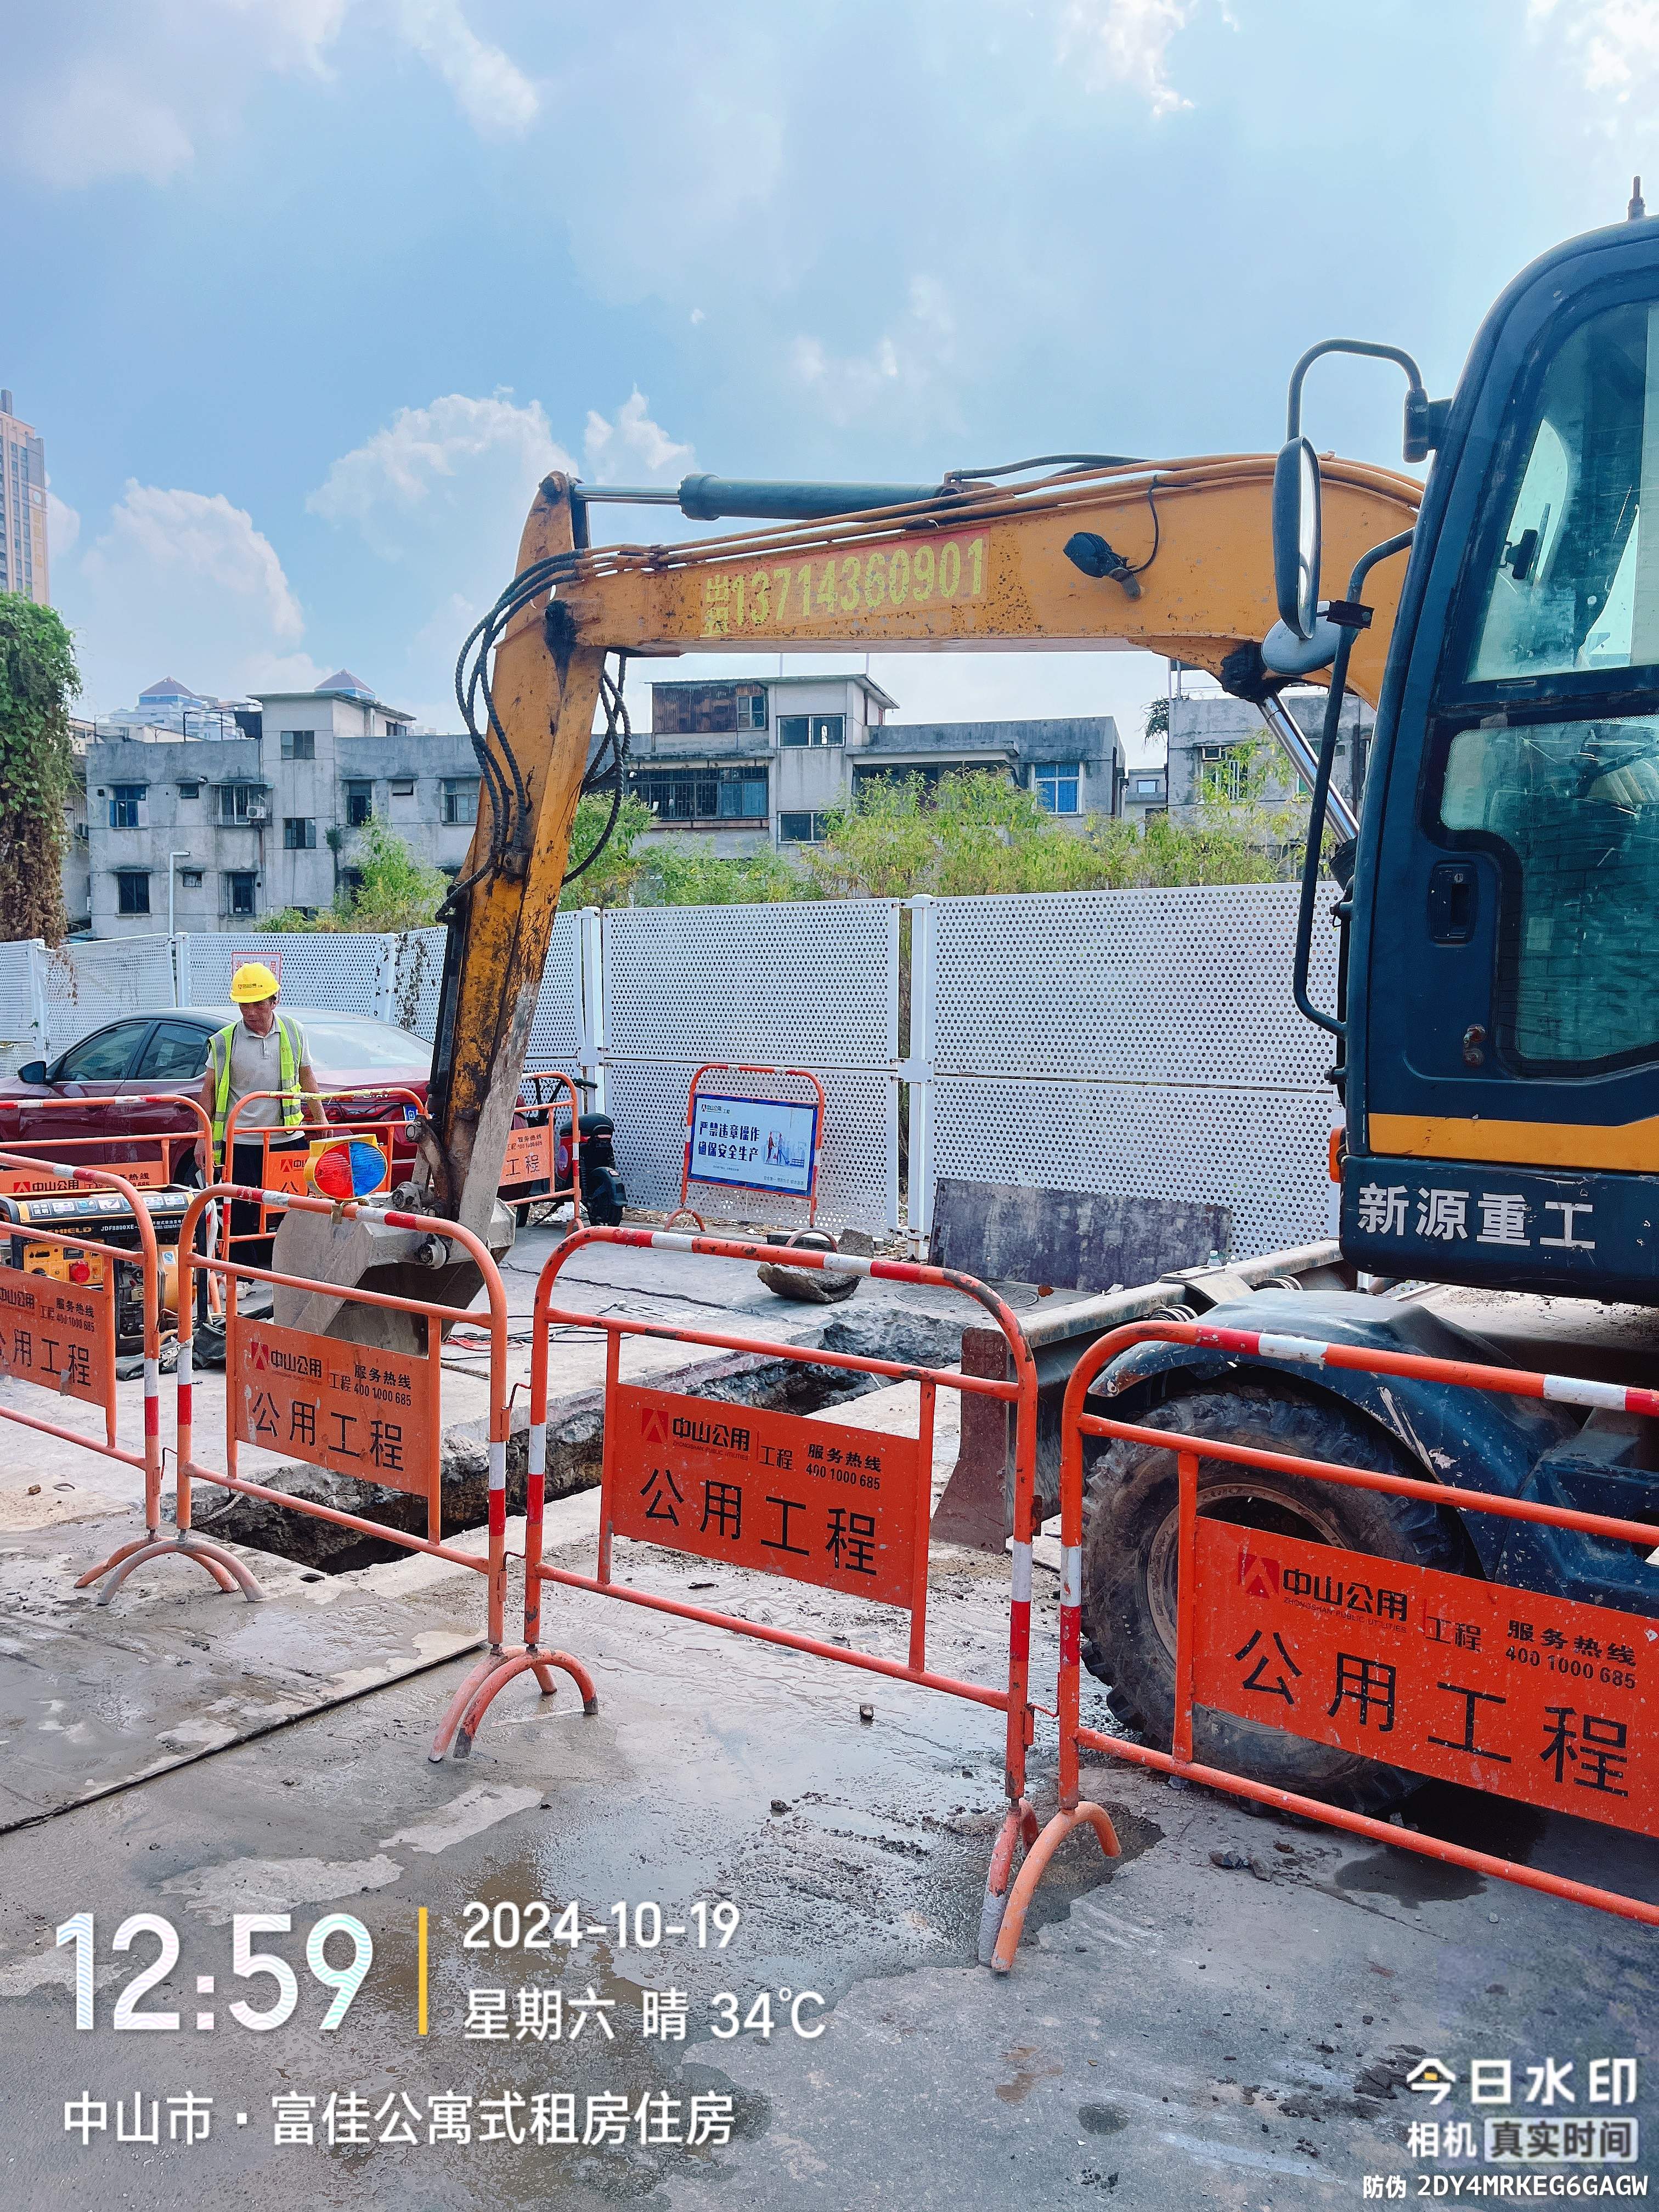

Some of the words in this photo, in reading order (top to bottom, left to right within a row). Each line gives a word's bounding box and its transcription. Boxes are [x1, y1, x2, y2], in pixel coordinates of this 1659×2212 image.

[731, 538, 984, 627] 13714360901
[699, 1121, 760, 1142] 严禁违章操作
[506, 1155, 540, 1176] 工程
[698, 1141, 759, 1162] 确保安全生产
[1357, 1183, 1595, 1249] 新源重工
[0, 1328, 92, 1387] 用工程
[270, 1349, 322, 1378] 中山公用
[329, 1373, 351, 1392] 工程
[354, 1364, 411, 1390] 服务热线
[353, 1384, 370, 1397] 400
[372, 1387, 393, 1402] 1000
[395, 1392, 411, 1407] 685
[252, 1392, 404, 1472] 公用工程
[673, 1417, 751, 1452] 中山公用
[759, 1445, 793, 1471] 工程
[807, 1443, 882, 1473] 服务热线
[805, 1463, 826, 1478] 400
[830, 1468, 857, 1485] 1000
[859, 1474, 881, 1490] 685
[640, 1469, 877, 1576] 公用工程
[1283, 1568, 1408, 1622] 中山公用
[1425, 1616, 1482, 1652] 工程
[1506, 1620, 1637, 1667] 服务热线
[1505, 1645, 1541, 1667] 400
[1547, 1654, 1594, 1679] 1000
[1599, 1667, 1637, 1690] 685
[1234, 1629, 1629, 1798] 公用工程
